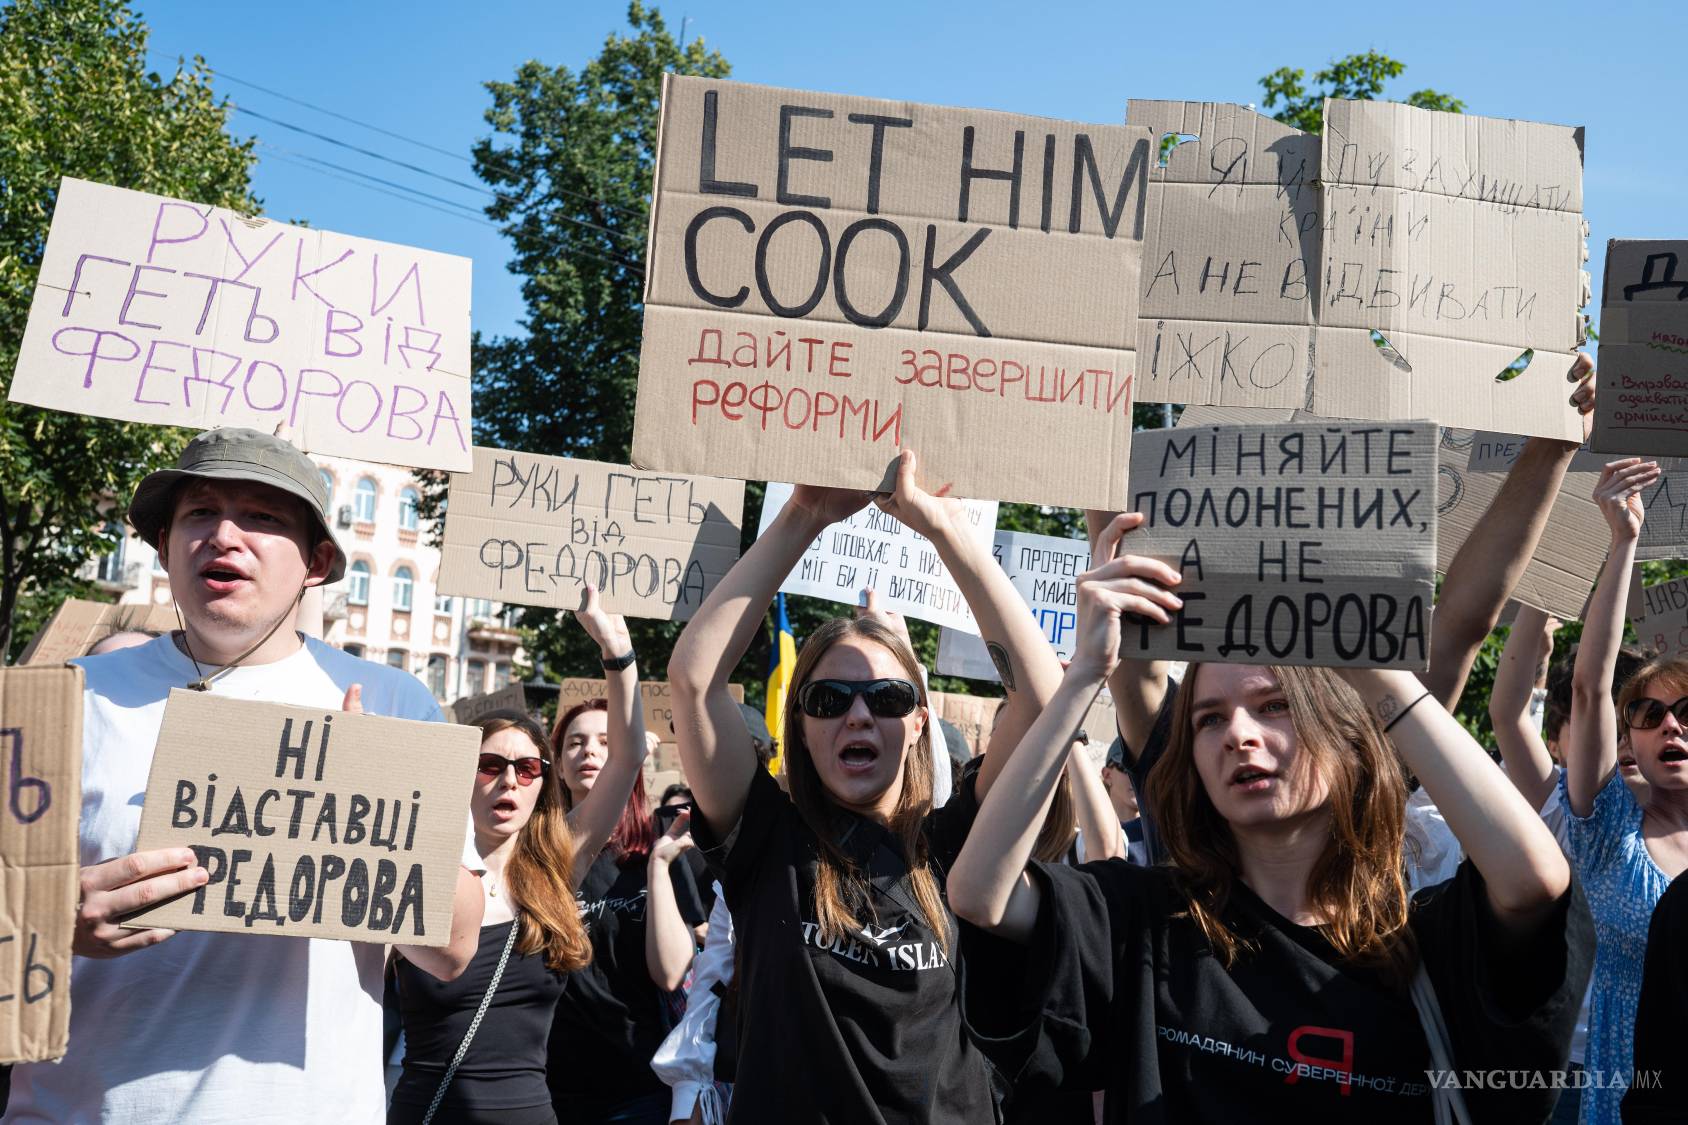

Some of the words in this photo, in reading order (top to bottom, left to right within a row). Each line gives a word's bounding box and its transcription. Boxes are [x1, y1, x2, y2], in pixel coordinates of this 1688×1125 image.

[699, 89, 914, 215] LET
[958, 125, 1150, 241] HIM
[1208, 137, 1248, 199] Я
[1275, 143, 1389, 202] ЙДУ
[147, 202, 425, 326] РУКИ
[684, 206, 993, 338] COOK
[1146, 251, 1180, 298] А
[62, 254, 280, 344] ГЕТЬ
[52, 327, 467, 453] ФЕДОРОВА
[1159, 427, 1415, 478] МІНЯЙТЕ
[490, 456, 579, 515] РУКИ
[604, 473, 707, 525] ГЕТЬ
[1135, 486, 1428, 533] ПОЛОНЕНИХ,
[479, 538, 705, 606] ФЕДОРОВА
[836, 564, 857, 589] БИ
[1179, 538, 1204, 582] А
[1258, 540, 1324, 584] НЕ
